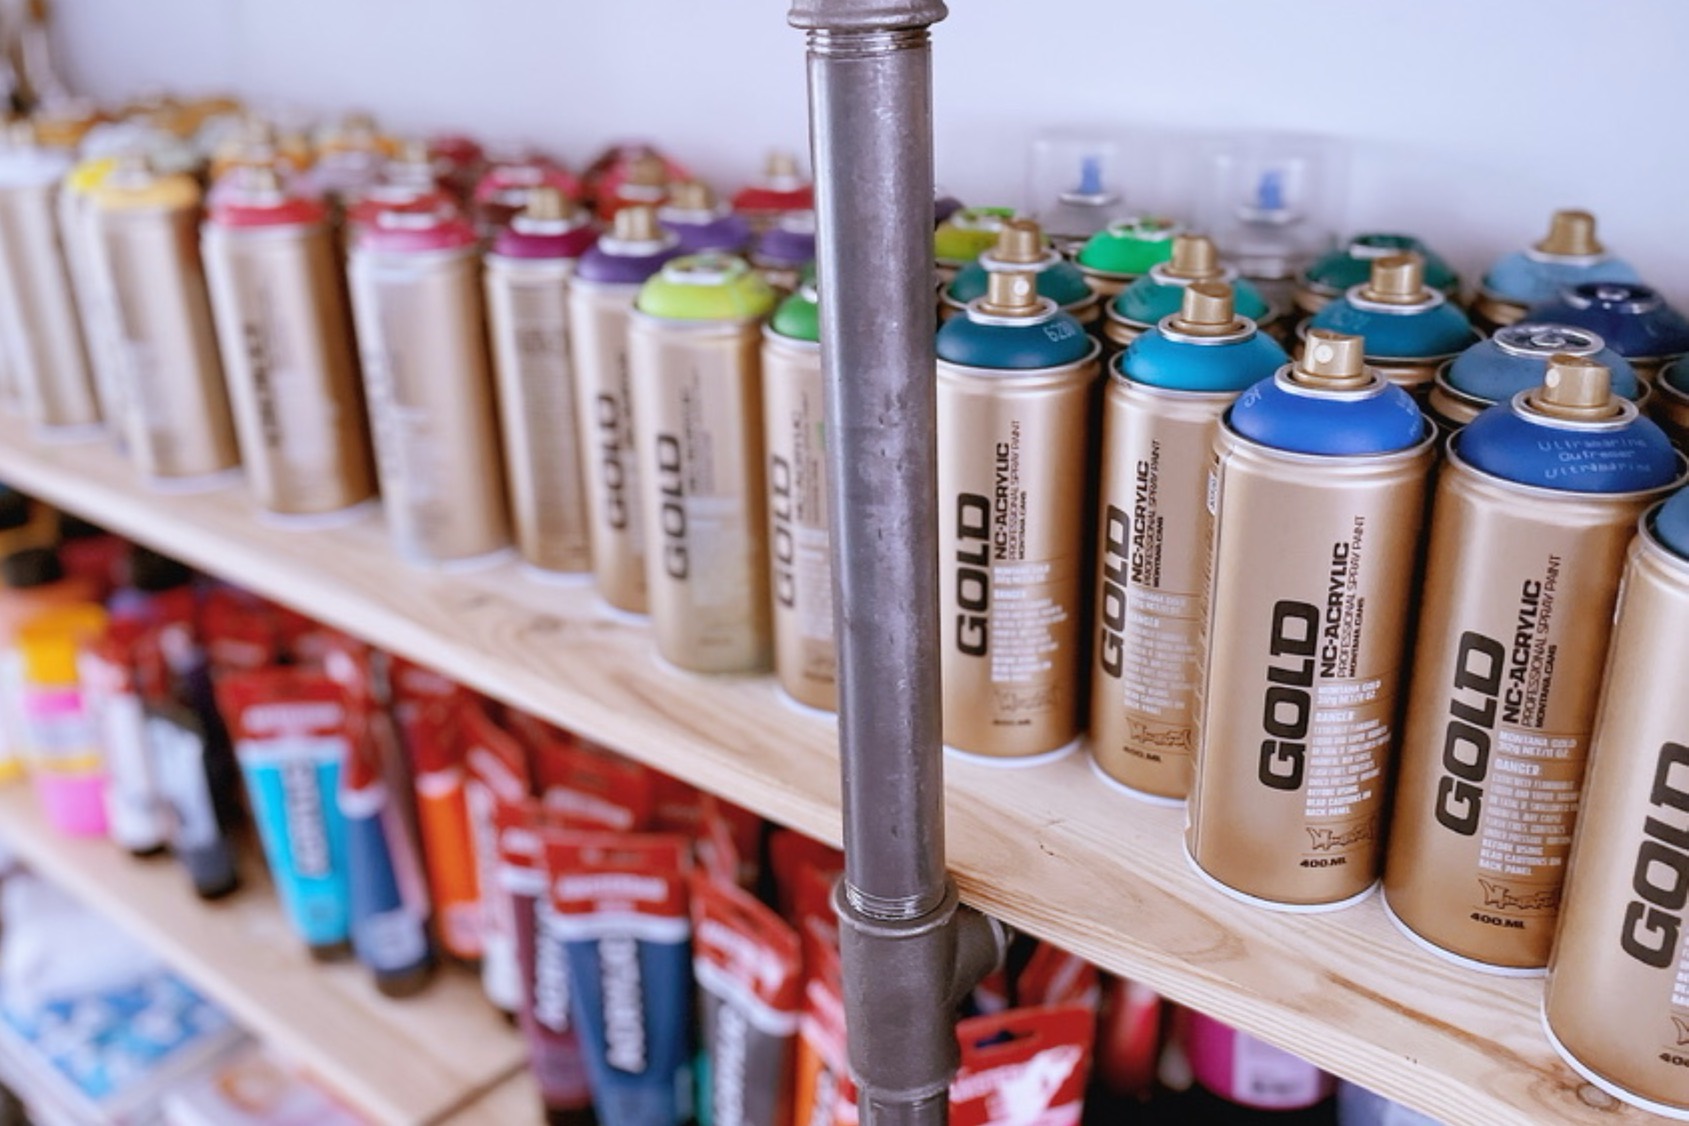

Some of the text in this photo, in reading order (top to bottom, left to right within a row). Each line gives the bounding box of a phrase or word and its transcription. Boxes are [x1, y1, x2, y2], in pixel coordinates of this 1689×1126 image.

[598, 393, 627, 530] GOLD
[657, 434, 690, 581] GOLD
[772, 455, 795, 610] GOLD
[1131, 460, 1149, 583] NC-ACRYLIC
[956, 492, 991, 657] GOLD
[1101, 504, 1130, 679] GOLD
[1320, 542, 1350, 678] NC-ACRYLIC
[1336, 515, 1366, 678] PROFESSIONAL SPRAY PAINT
[1502, 579, 1542, 723] NC-ACRYLIC
[1520, 554, 1562, 728] PROFESSIONAL SPRAY PAINT
[1258, 600, 1320, 790] GOLD
[1436, 630, 1506, 836] GOLD
[1499, 730, 1548, 746] MONTANA
[1620, 741, 1689, 970] GOLD
